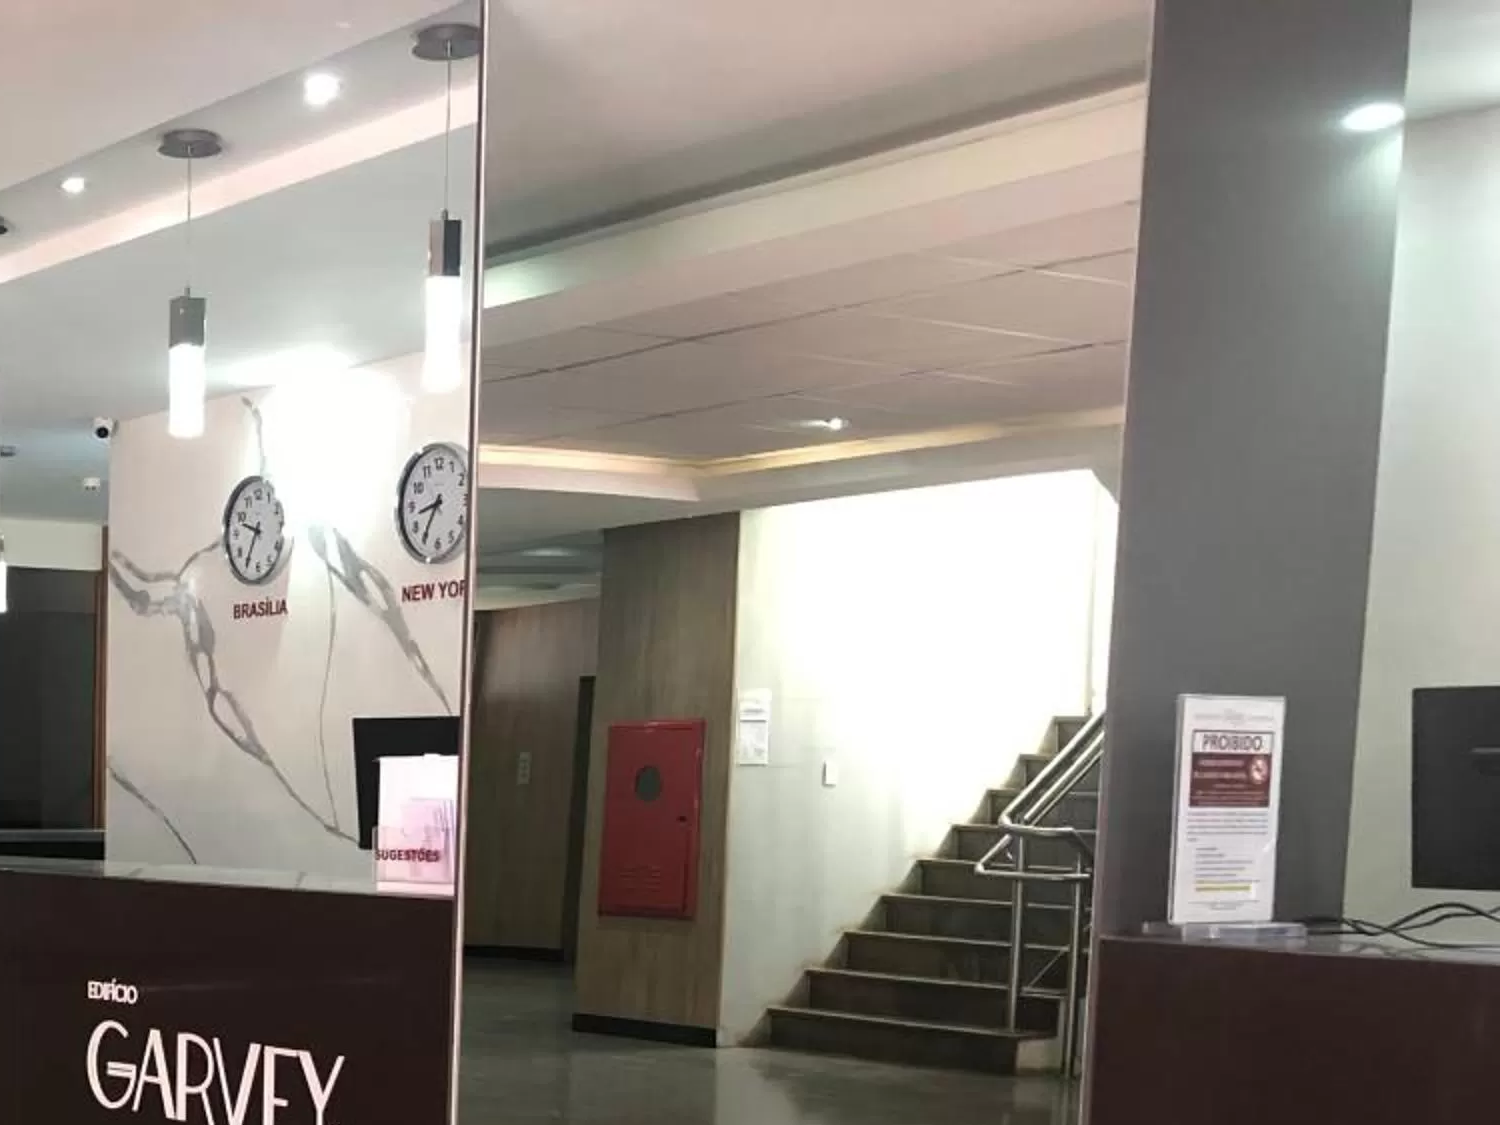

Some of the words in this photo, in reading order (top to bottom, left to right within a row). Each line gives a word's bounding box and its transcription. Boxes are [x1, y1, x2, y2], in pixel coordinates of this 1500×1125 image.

[433, 456, 445, 471] 12
[413, 481, 425, 495] 10
[402, 582, 435, 602] NEW
[438, 579, 468, 600] YOR
[233, 597, 289, 620] BRASÍLIA
[1202, 733, 1264, 752] PROIBIDO
[374, 847, 442, 863] SUGESTÕES
[87, 977, 139, 1005] EDIFÍCIO
